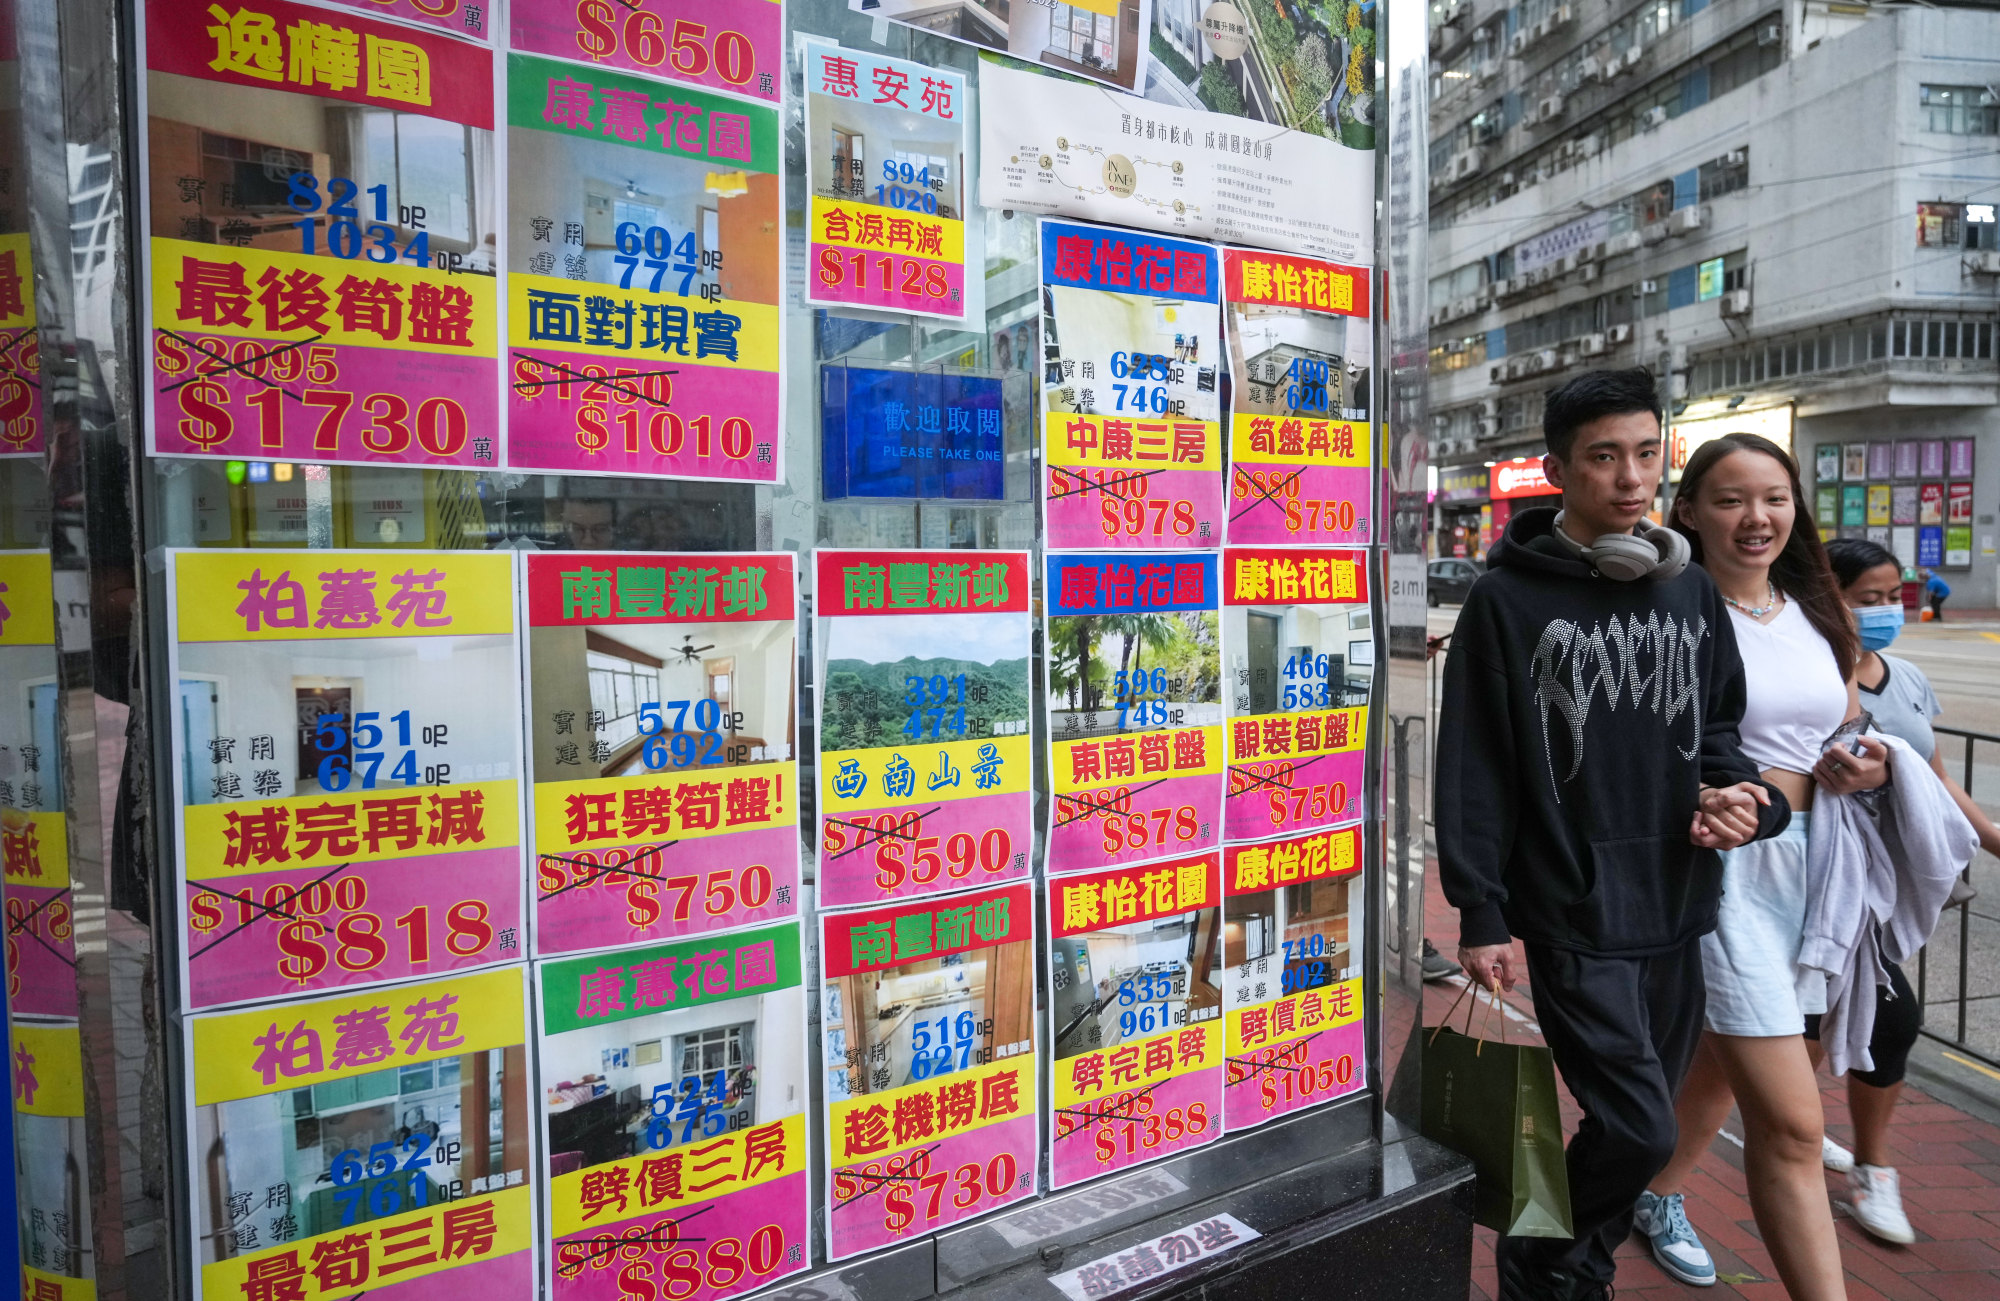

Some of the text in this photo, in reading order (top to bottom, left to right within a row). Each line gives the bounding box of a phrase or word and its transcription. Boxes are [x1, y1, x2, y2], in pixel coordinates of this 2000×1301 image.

[206, 3, 431, 106] 逸樺園
[542, 74, 751, 163] 康蕙花園
[820, 54, 954, 121] 惠安苑
[819, 246, 948, 298] $1128
[1053, 234, 1206, 296] 康怡花園
[1241, 259, 1353, 312] 康怡花園
[175, 256, 474, 348] 最後筍盤
[528, 288, 742, 362] 面對現實
[178, 376, 468, 458] $1730
[575, 402, 753, 460] $1010
[1066, 417, 1206, 464] 中康三房
[1249, 417, 1355, 458] 筍盤再現
[883, 446, 1000, 461] PLEASE TAKE ONE
[1100, 496, 1196, 539] $978
[1285, 497, 1356, 534] $750
[235, 567, 454, 632] 柏蕙苑
[560, 565, 768, 619] 南豐新邨
[843, 562, 1009, 610] 南豐新邨
[1059, 562, 1205, 609] 康怡花園
[1234, 558, 1358, 601] 康怡花園
[831, 743, 1004, 800] 西南山景
[1070, 730, 1206, 785] 東南筍盤
[222, 789, 486, 870] 減完再減
[1102, 805, 1199, 857] $878
[1269, 782, 1347, 828] $750
[874, 827, 1012, 895] $590
[1235, 830, 1355, 891] 康怡花園
[626, 863, 773, 931] $750
[1062, 862, 1208, 931] 康怡花園
[276, 899, 494, 986] $818
[850, 897, 1011, 969] 南豐新邨
[575, 939, 777, 1021] 康蕙花園
[251, 993, 466, 1086] 柏蕙苑
[1261, 1054, 1353, 1112] $1050
[1095, 1101, 1208, 1164] $1388
[884, 1152, 1018, 1235] $730
[618, 1224, 785, 1301] $880
